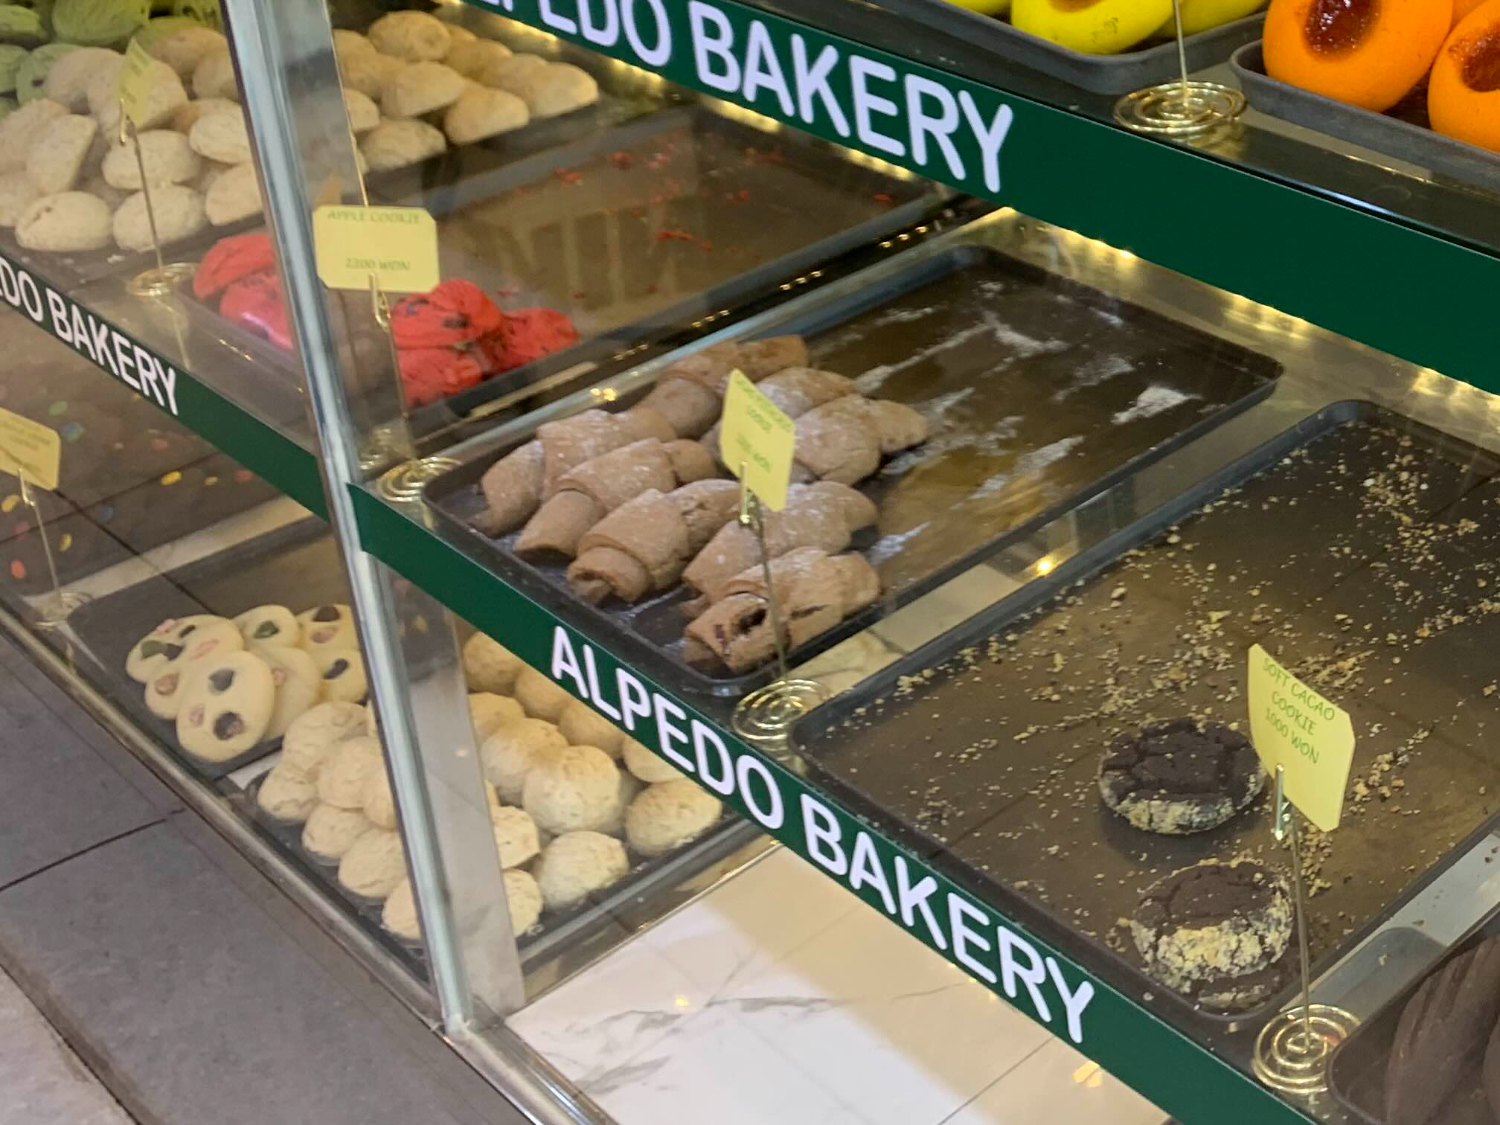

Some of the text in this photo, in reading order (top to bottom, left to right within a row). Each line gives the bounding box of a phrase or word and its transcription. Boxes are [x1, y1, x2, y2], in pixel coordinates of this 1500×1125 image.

[688, 0, 1014, 194] BAKERY
[46, 287, 179, 416] BAKERY
[1263, 657, 1335, 721] SOFT CACAO
[1272, 691, 1317, 736] COOKIE
[1291, 730, 1319, 765] WON
[551, 625, 1096, 1045] ALPEDO BAKERY
